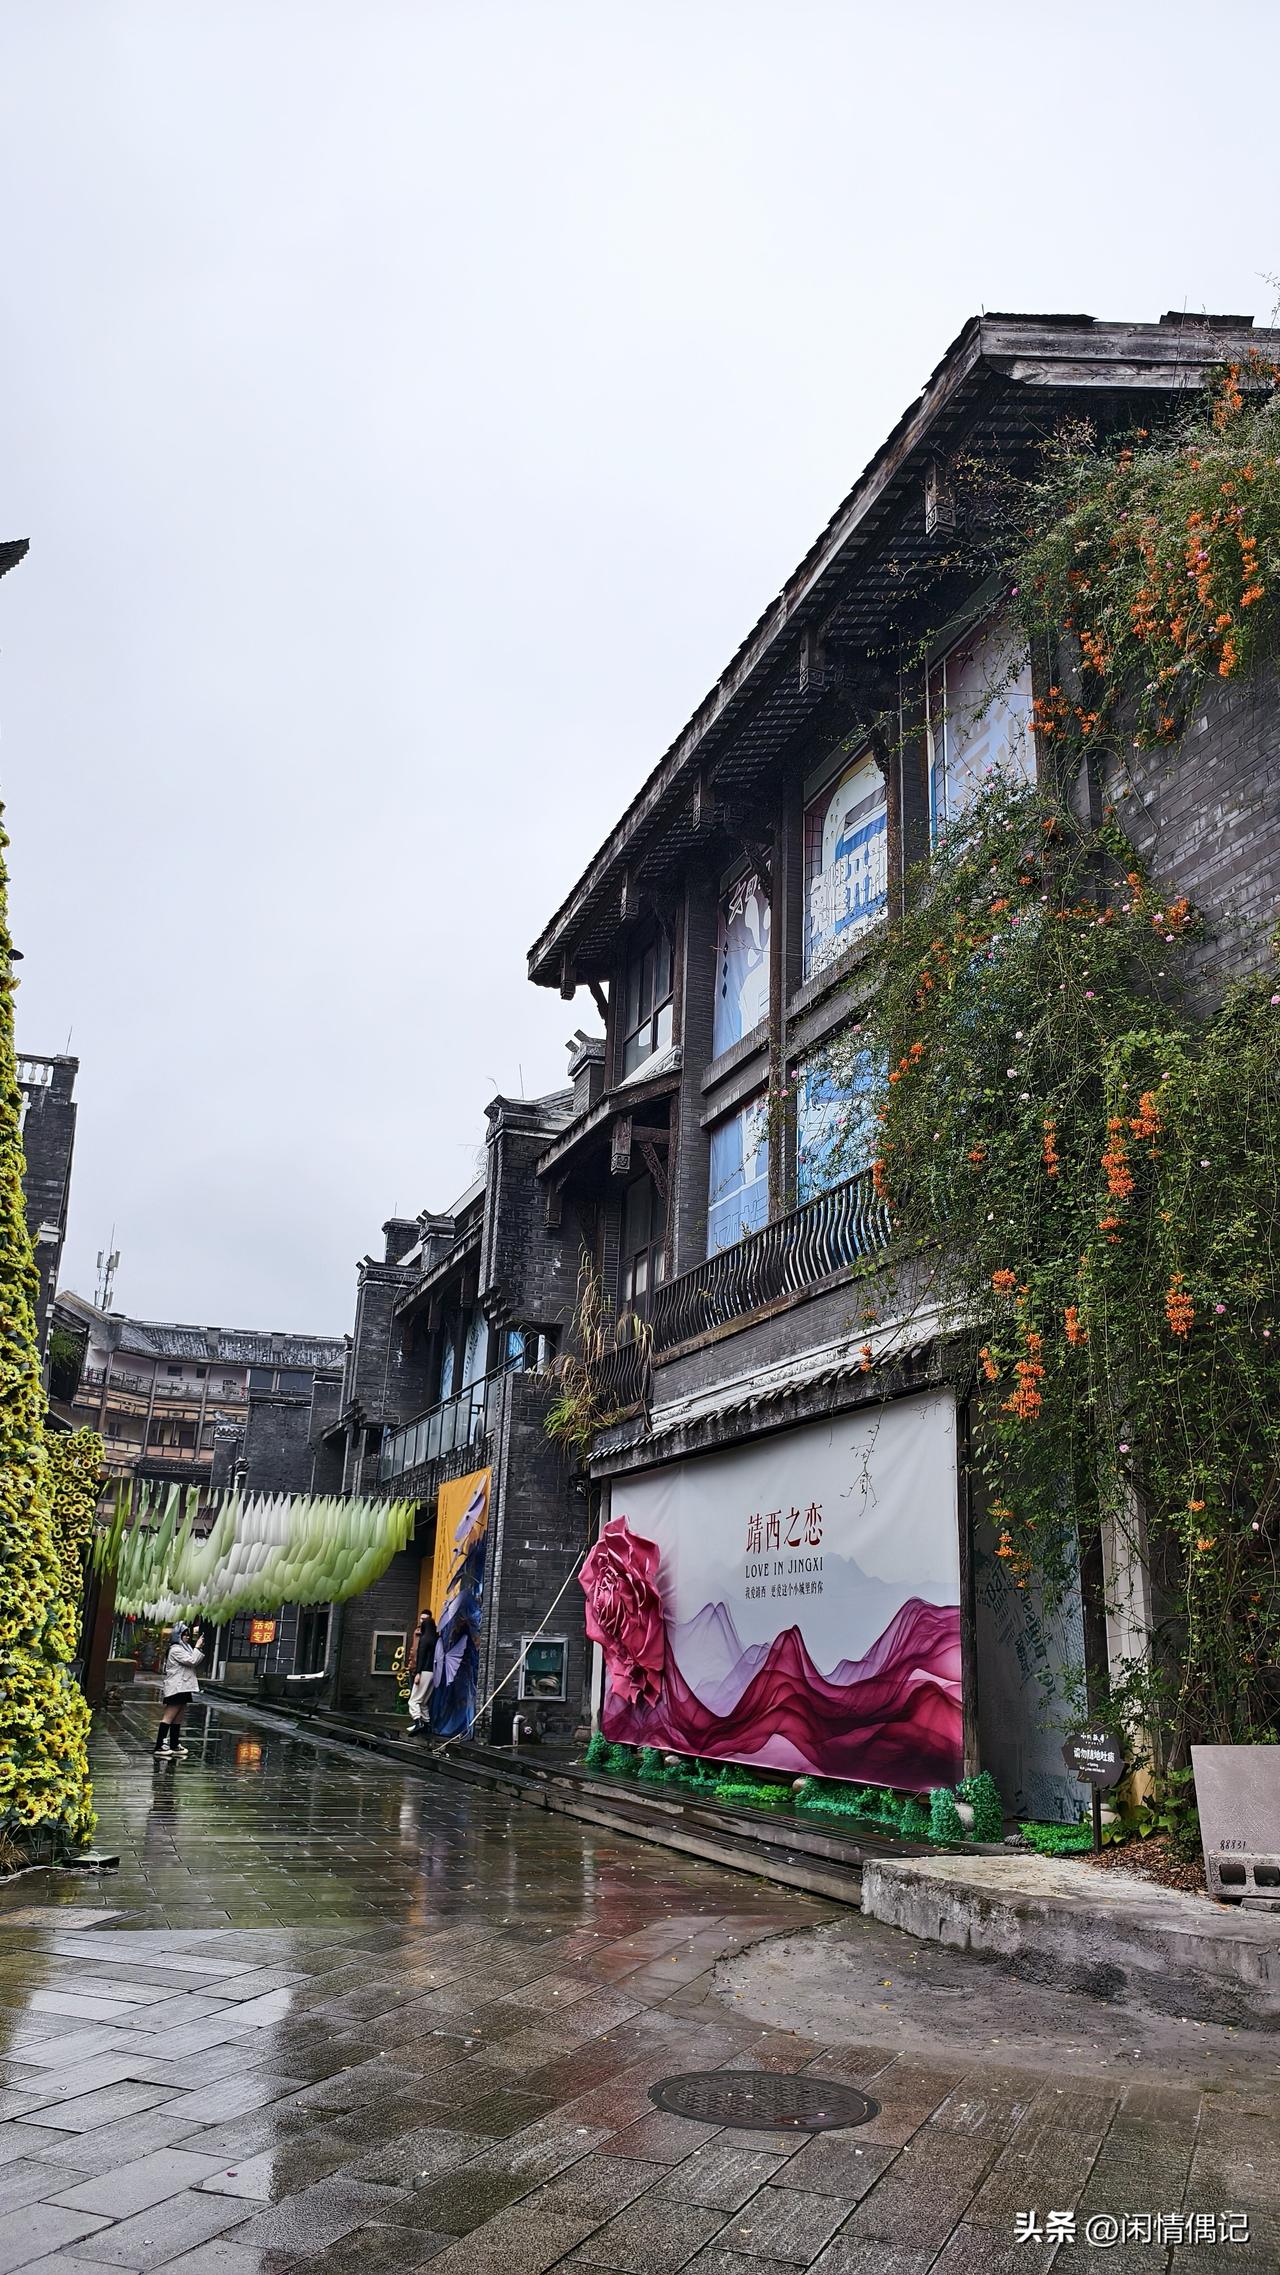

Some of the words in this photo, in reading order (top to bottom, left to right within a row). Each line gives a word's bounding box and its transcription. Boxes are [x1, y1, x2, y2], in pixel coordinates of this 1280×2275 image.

[746, 1502, 823, 1554] 靖西之恋
[745, 1563, 769, 1578] LOVE
[774, 1561, 784, 1576] IN
[788, 1557, 823, 1574] JINGXI
[745, 1585, 766, 1599] 我爱靖西
[254, 1620, 274, 1630] 活动
[253, 1631, 273, 1642] 专区
